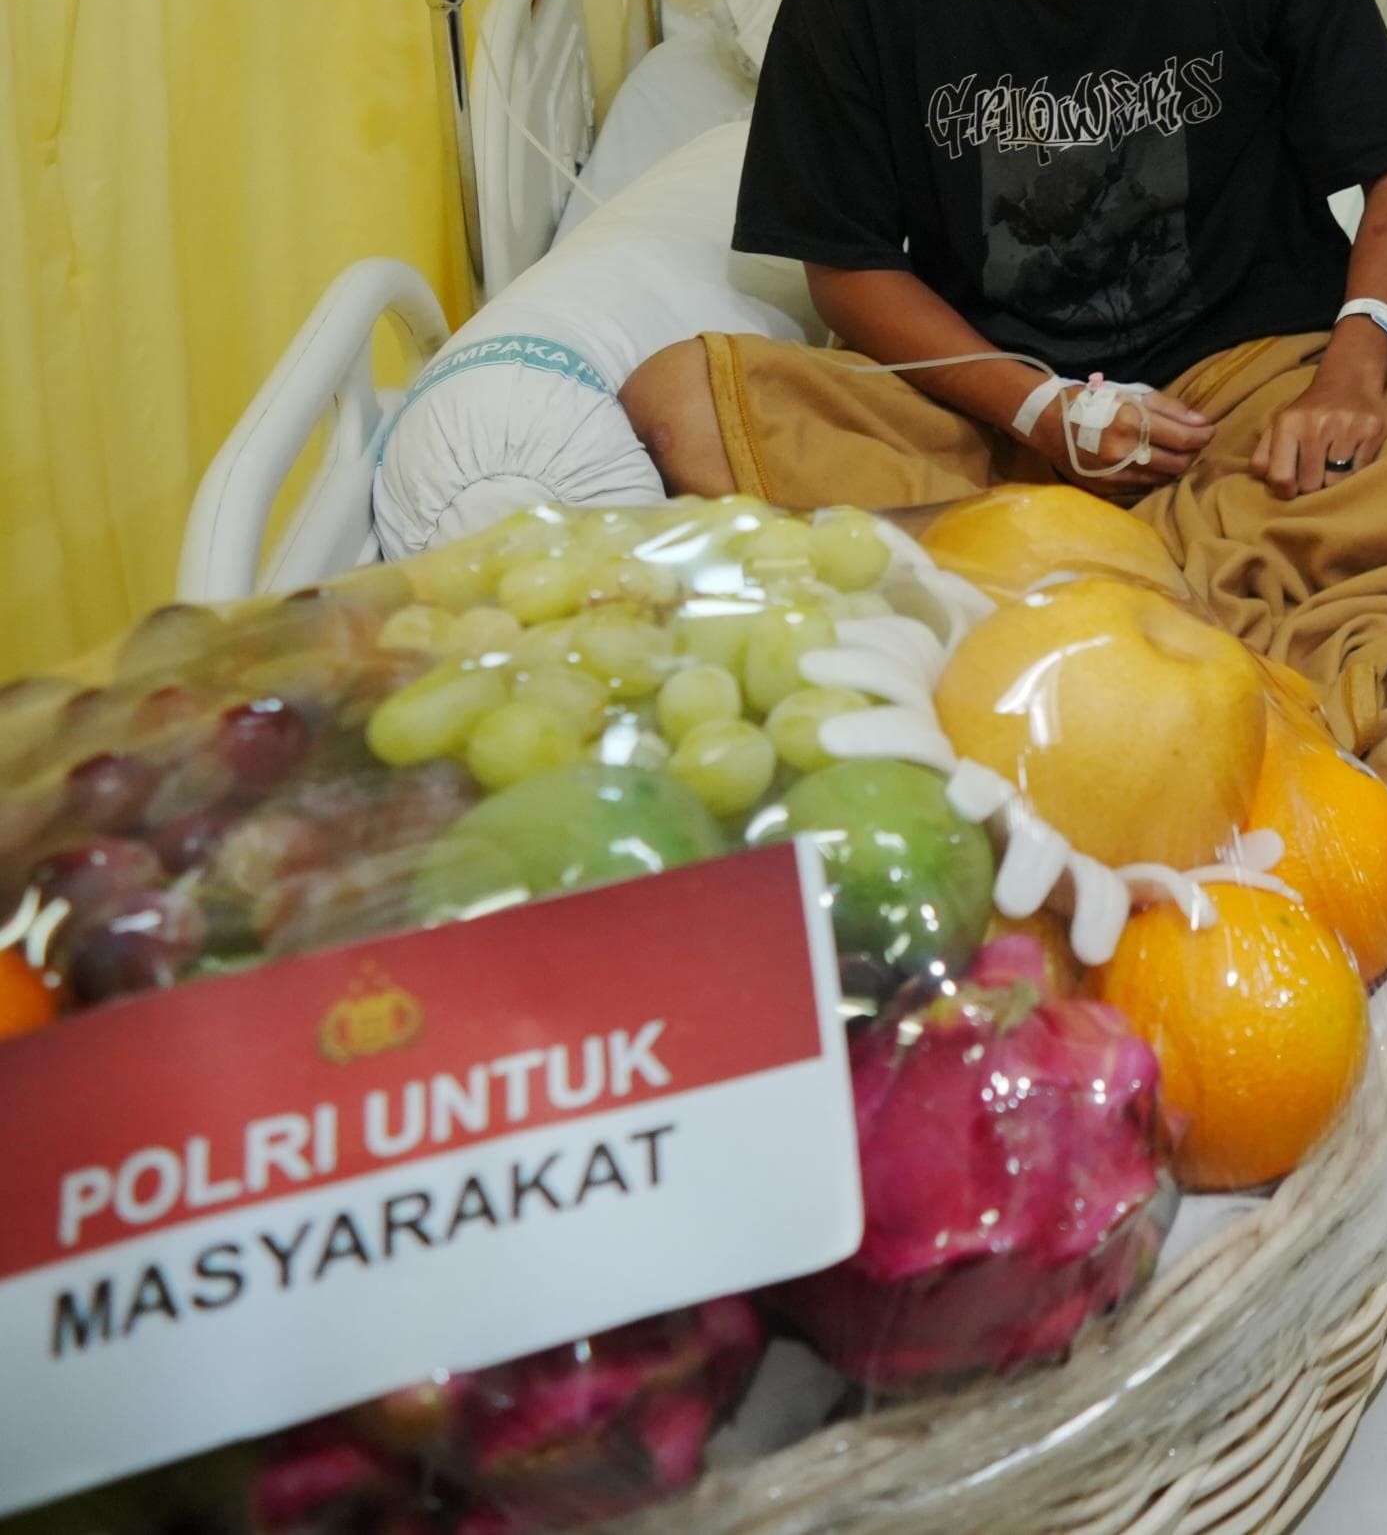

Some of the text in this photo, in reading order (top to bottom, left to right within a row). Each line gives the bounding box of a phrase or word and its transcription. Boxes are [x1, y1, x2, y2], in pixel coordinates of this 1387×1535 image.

[415, 341, 569, 390] CEMPAKA
[51, 1124, 677, 1360] MASYARAKAT
[57, 1021, 674, 1248] POLRI UNTUK
